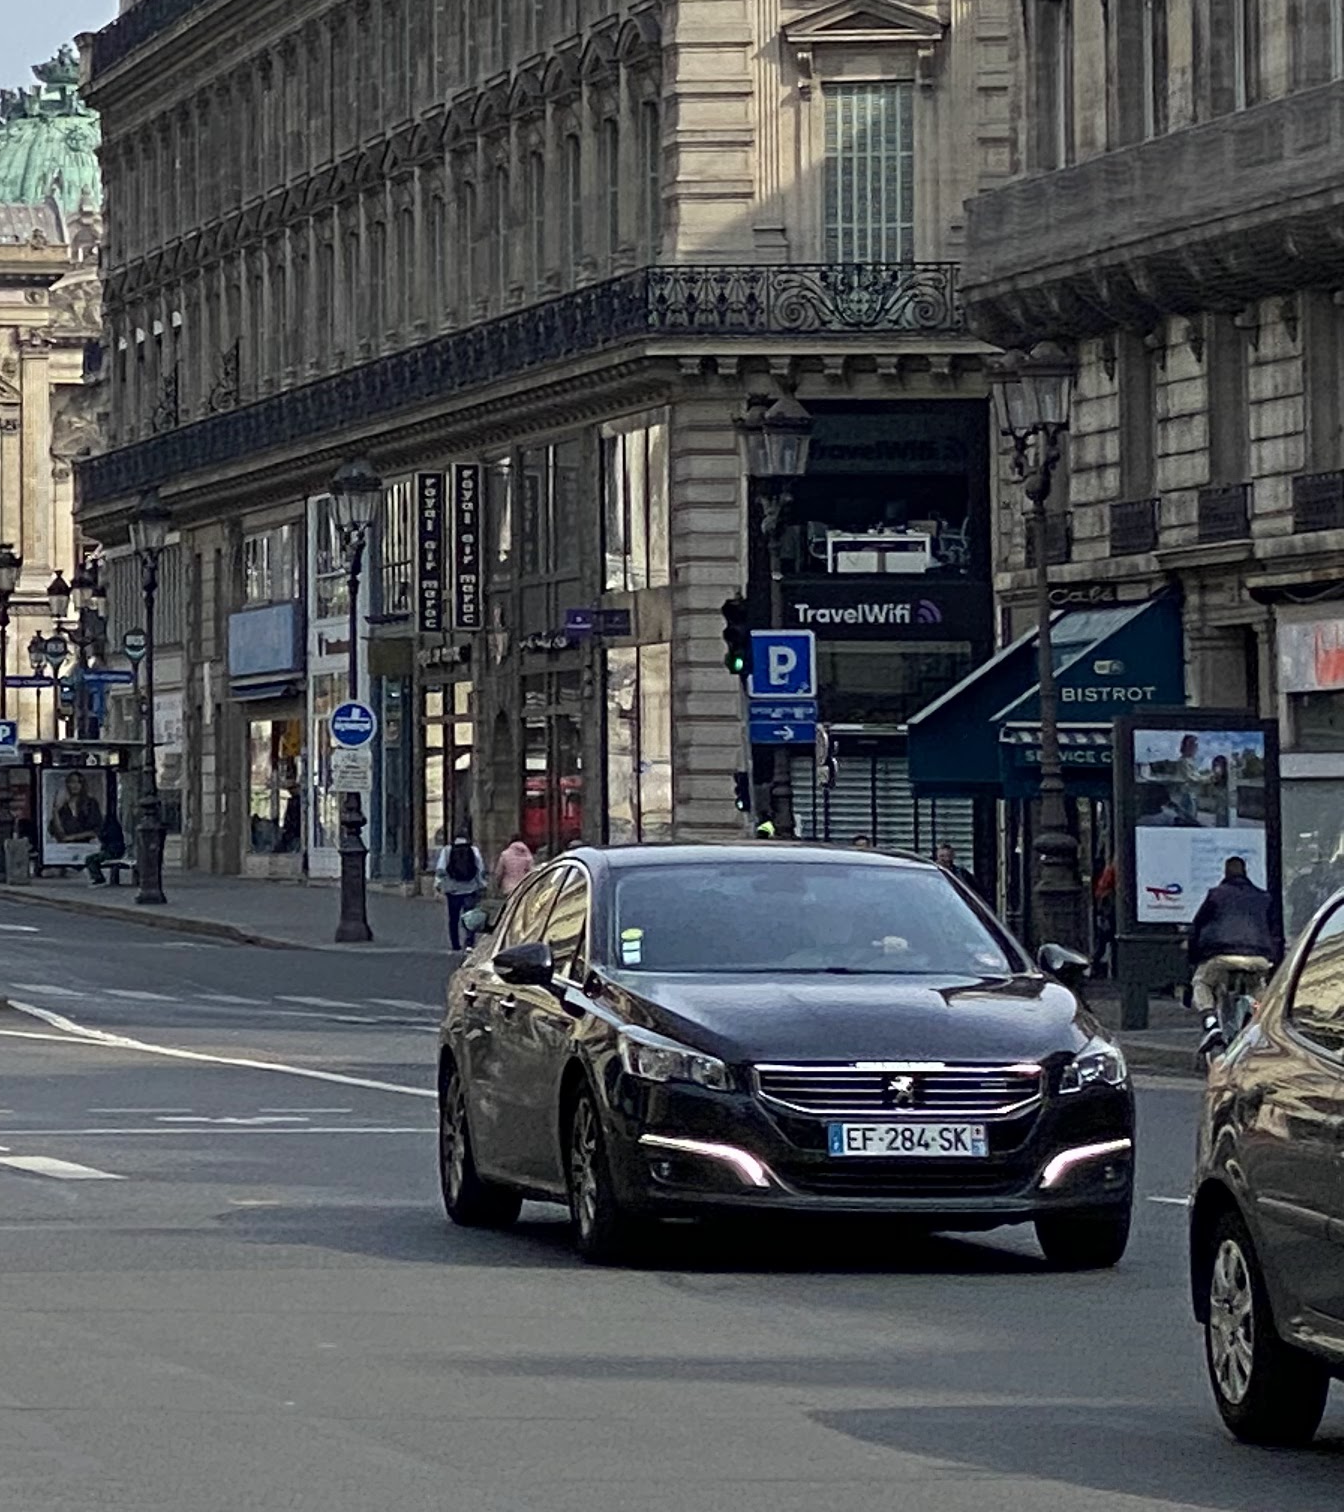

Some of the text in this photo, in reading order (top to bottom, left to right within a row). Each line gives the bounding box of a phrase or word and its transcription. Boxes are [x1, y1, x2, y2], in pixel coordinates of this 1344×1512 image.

[422, 478, 438, 628] royal air maroc
[460, 469, 476, 623] royal air maroc
[794, 603, 912, 624] TravelWifi
[768, 645, 798, 686] P
[1061, 686, 1156, 703] BISTROT
[1025, 749, 1097, 763] SEVICE
